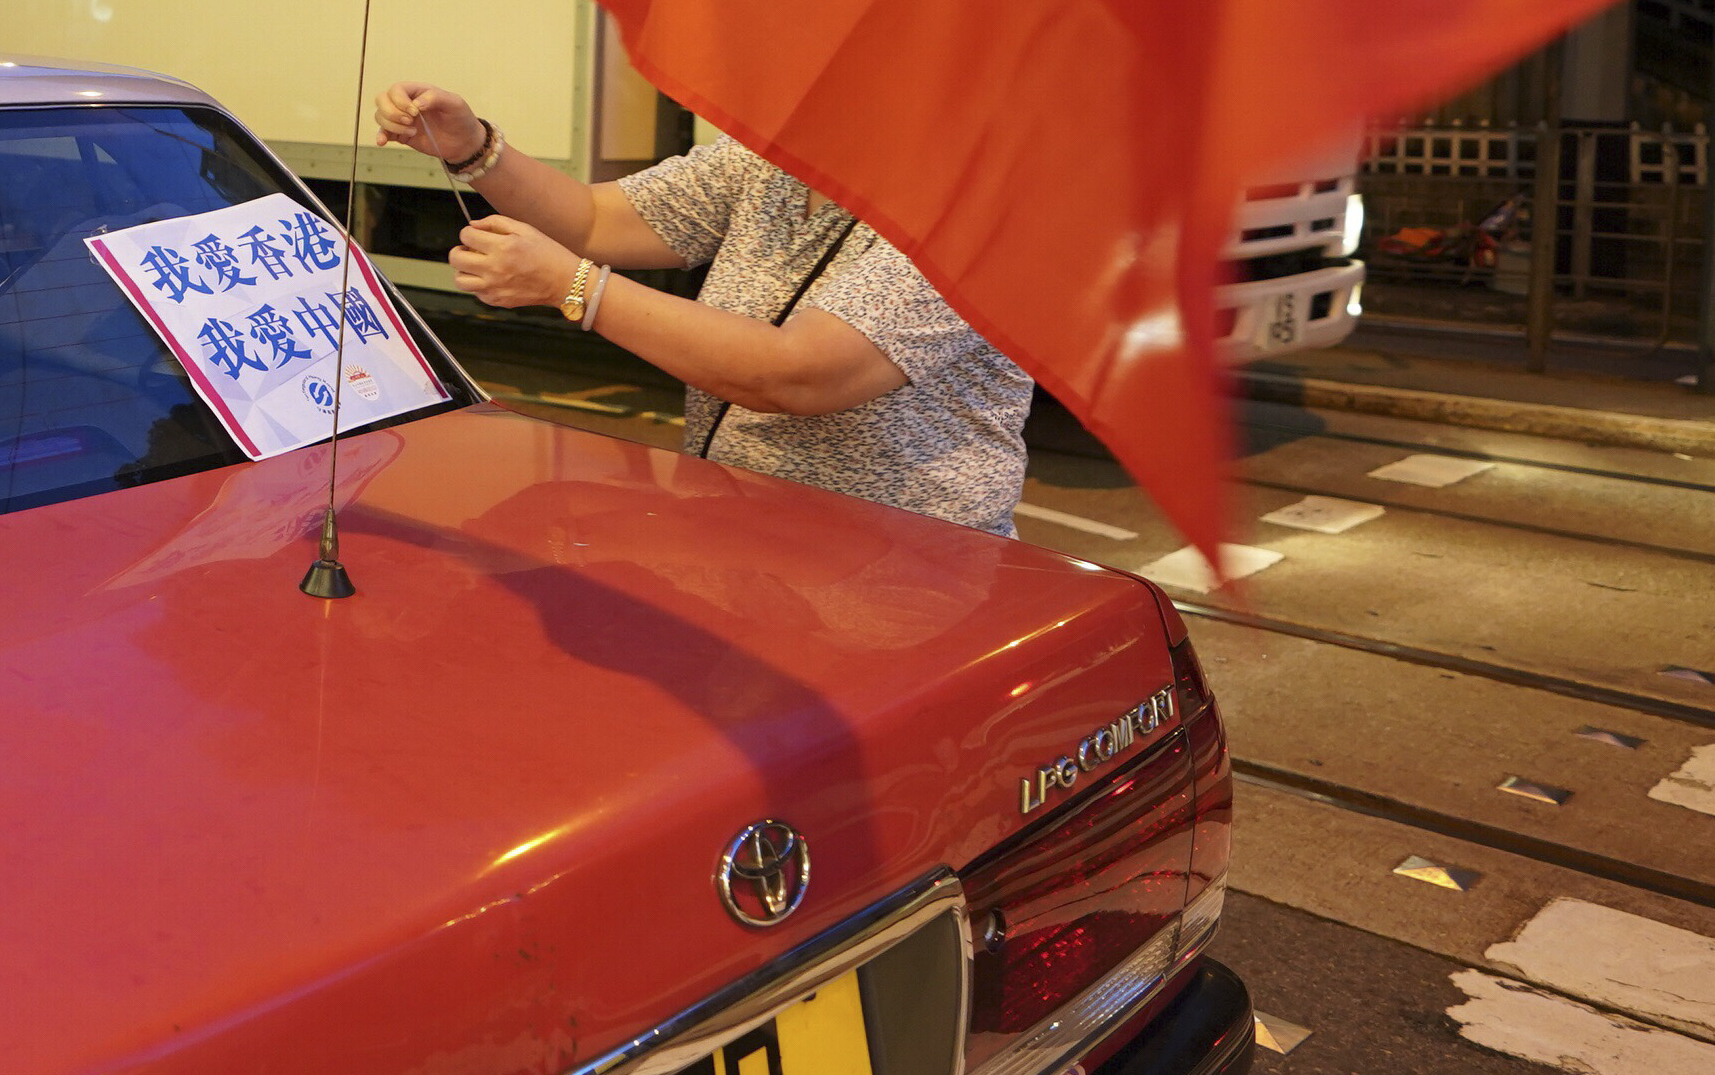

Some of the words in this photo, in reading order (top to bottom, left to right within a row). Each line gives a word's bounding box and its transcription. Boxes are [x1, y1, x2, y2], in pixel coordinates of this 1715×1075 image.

[139, 212, 342, 304] 我愛香港
[196, 286, 389, 380] 我愛中國
[1021, 755, 1078, 813] LPG
[1078, 683, 1175, 772] COMFORT
